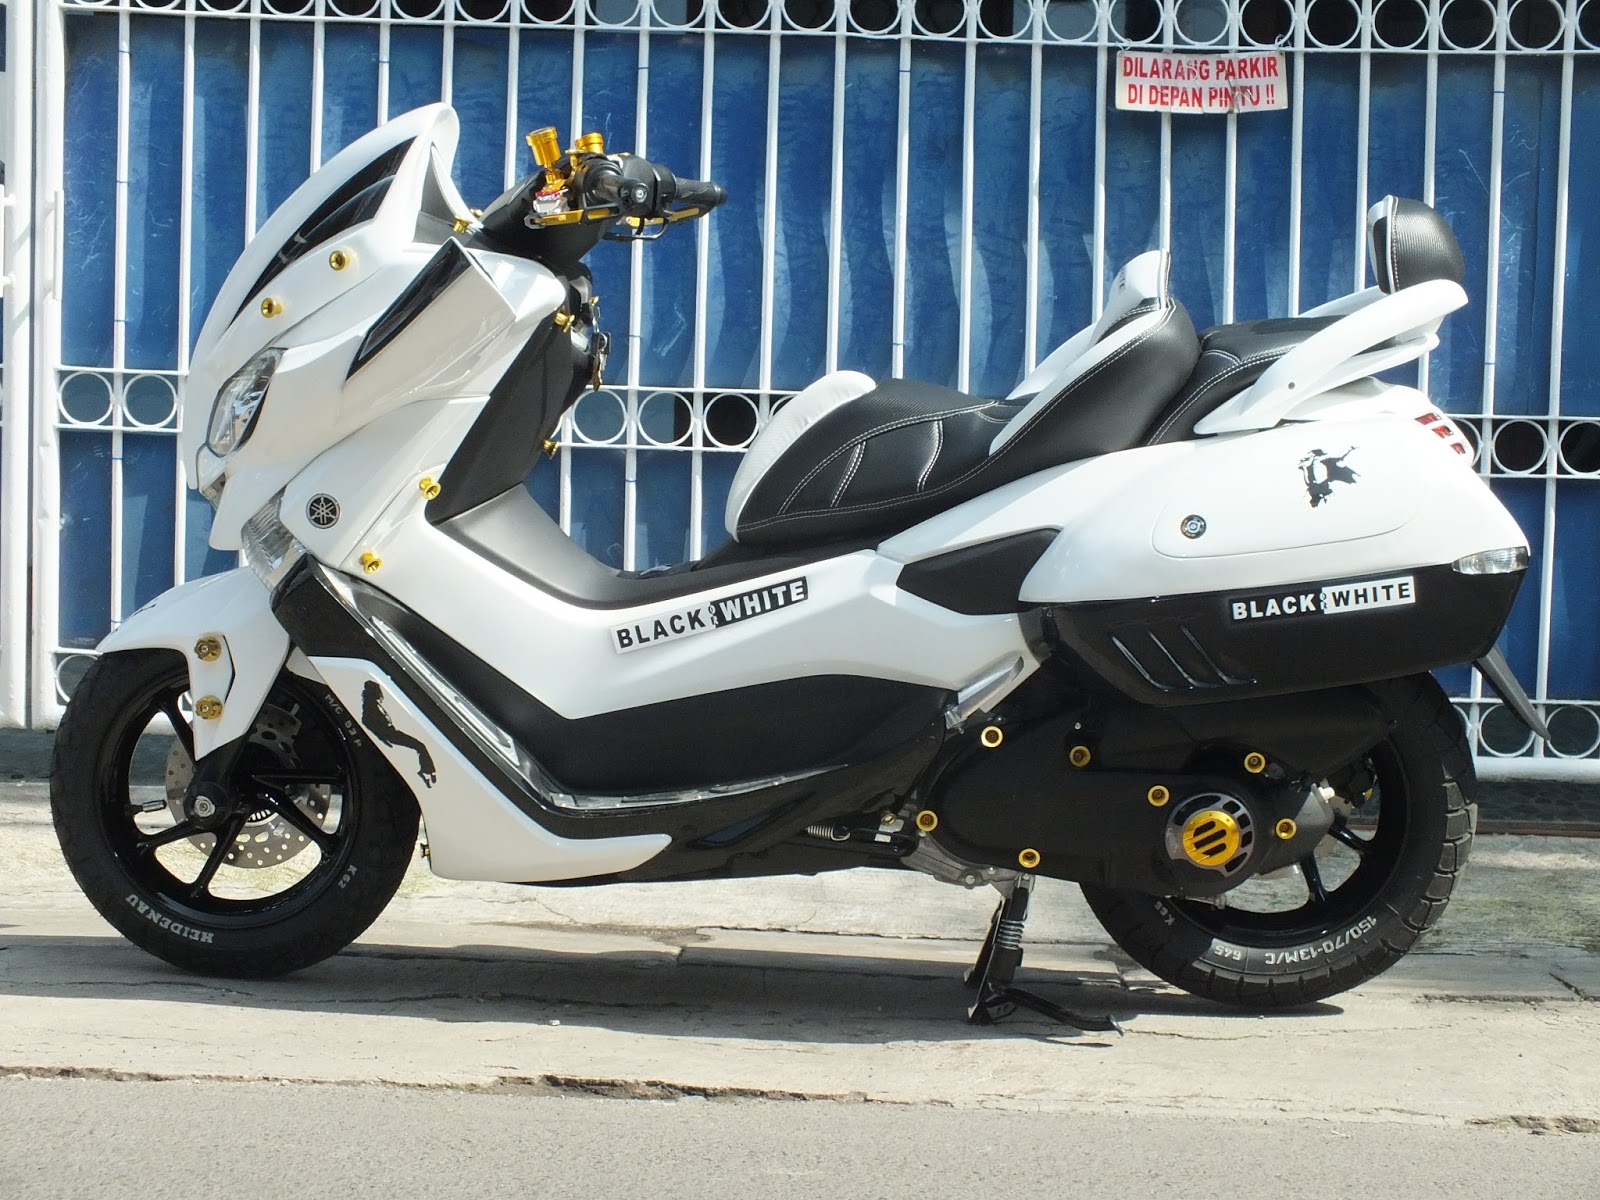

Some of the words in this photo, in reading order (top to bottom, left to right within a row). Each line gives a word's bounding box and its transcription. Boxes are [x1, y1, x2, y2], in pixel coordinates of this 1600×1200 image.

[1123, 56, 1210, 80] DILARANG
[1215, 56, 1279, 80] PARKIR
[1128, 83, 1143, 104] DI
[1149, 84, 1202, 108] DEPAN
[1208, 86, 1260, 108] PINTU
[1266, 83, 1275, 105] !!
[616, 609, 706, 648] BLACK
[719, 580, 805, 622] WHITE
[1232, 593, 1316, 620] BLACK
[1332, 582, 1411, 608] WHITE
[125, 894, 214, 943] HEIDENAU
